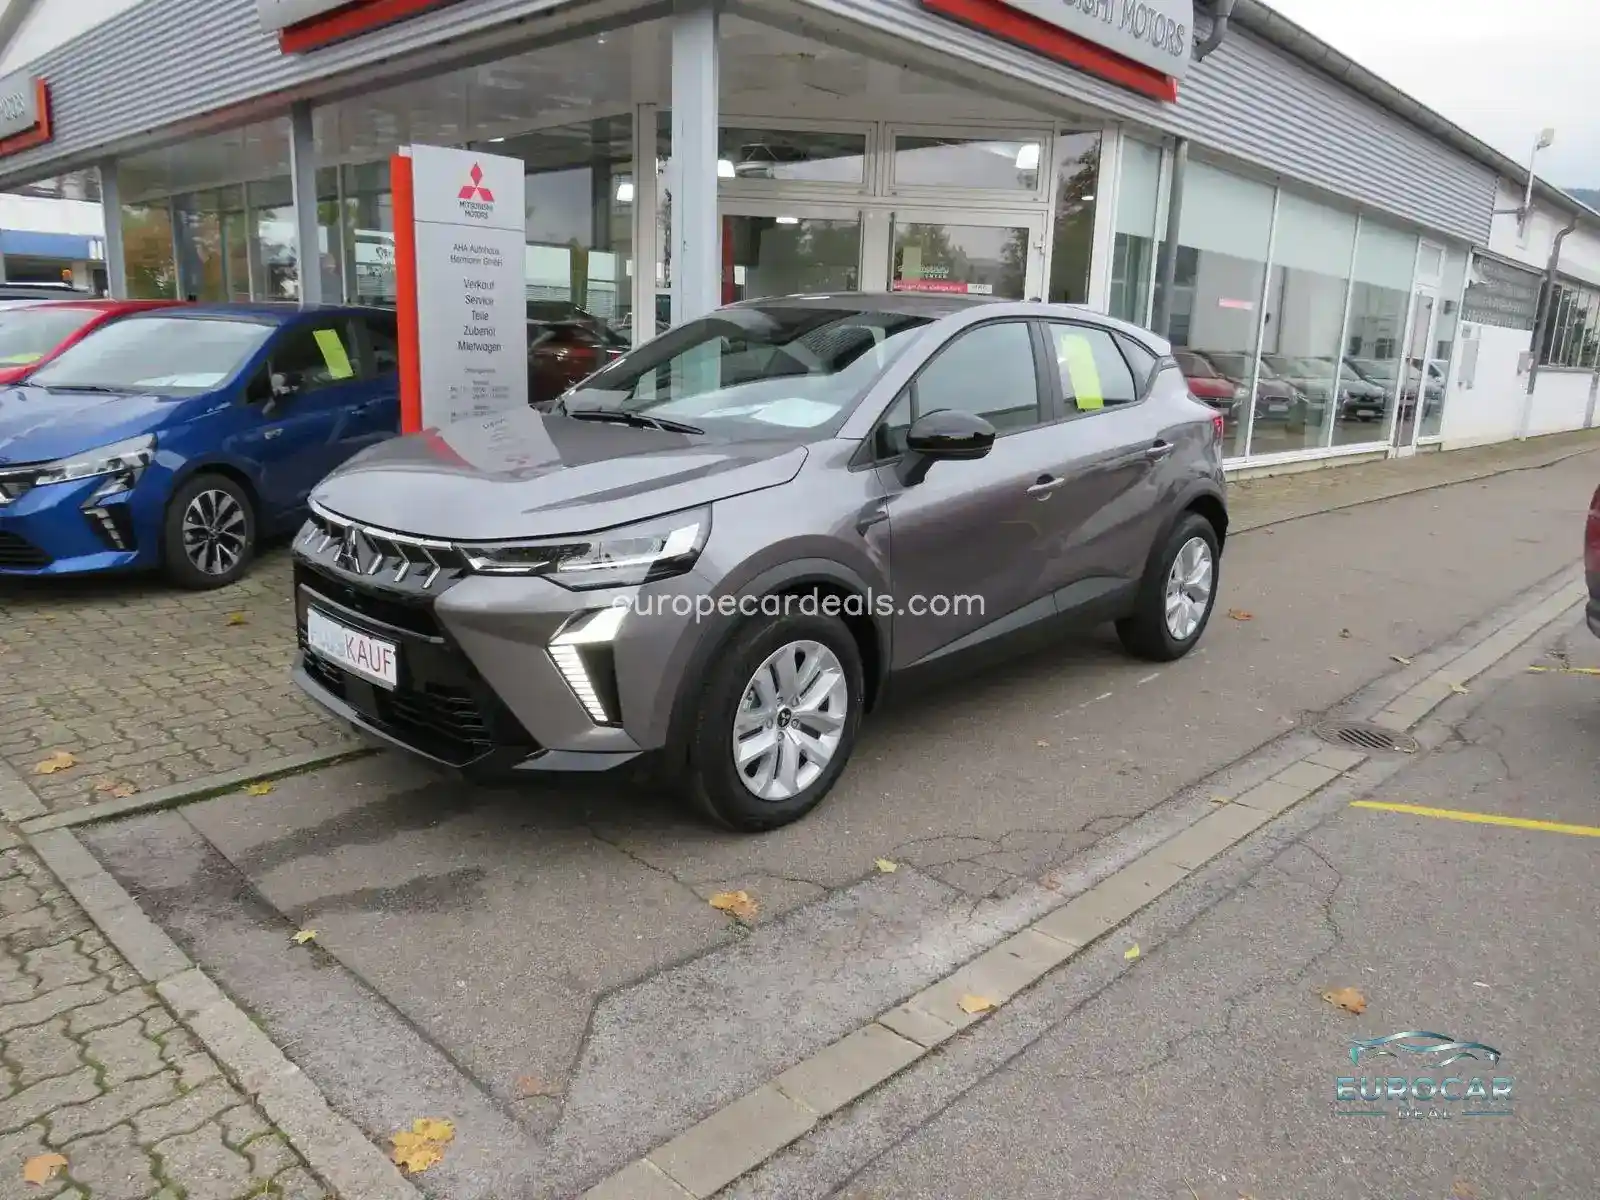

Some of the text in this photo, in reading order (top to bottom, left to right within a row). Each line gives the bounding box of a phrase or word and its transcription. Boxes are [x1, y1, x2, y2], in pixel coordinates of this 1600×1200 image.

[1118, 0, 1186, 58] MOTORS
[464, 210, 489, 220] MOTORS
[453, 243, 468, 252] AHA
[482, 257, 503, 267] GmbH
[463, 278, 495, 290] Verkauf
[464, 294, 494, 306] Service
[471, 309, 489, 321] Teile
[457, 340, 502, 354] Mietwagen
